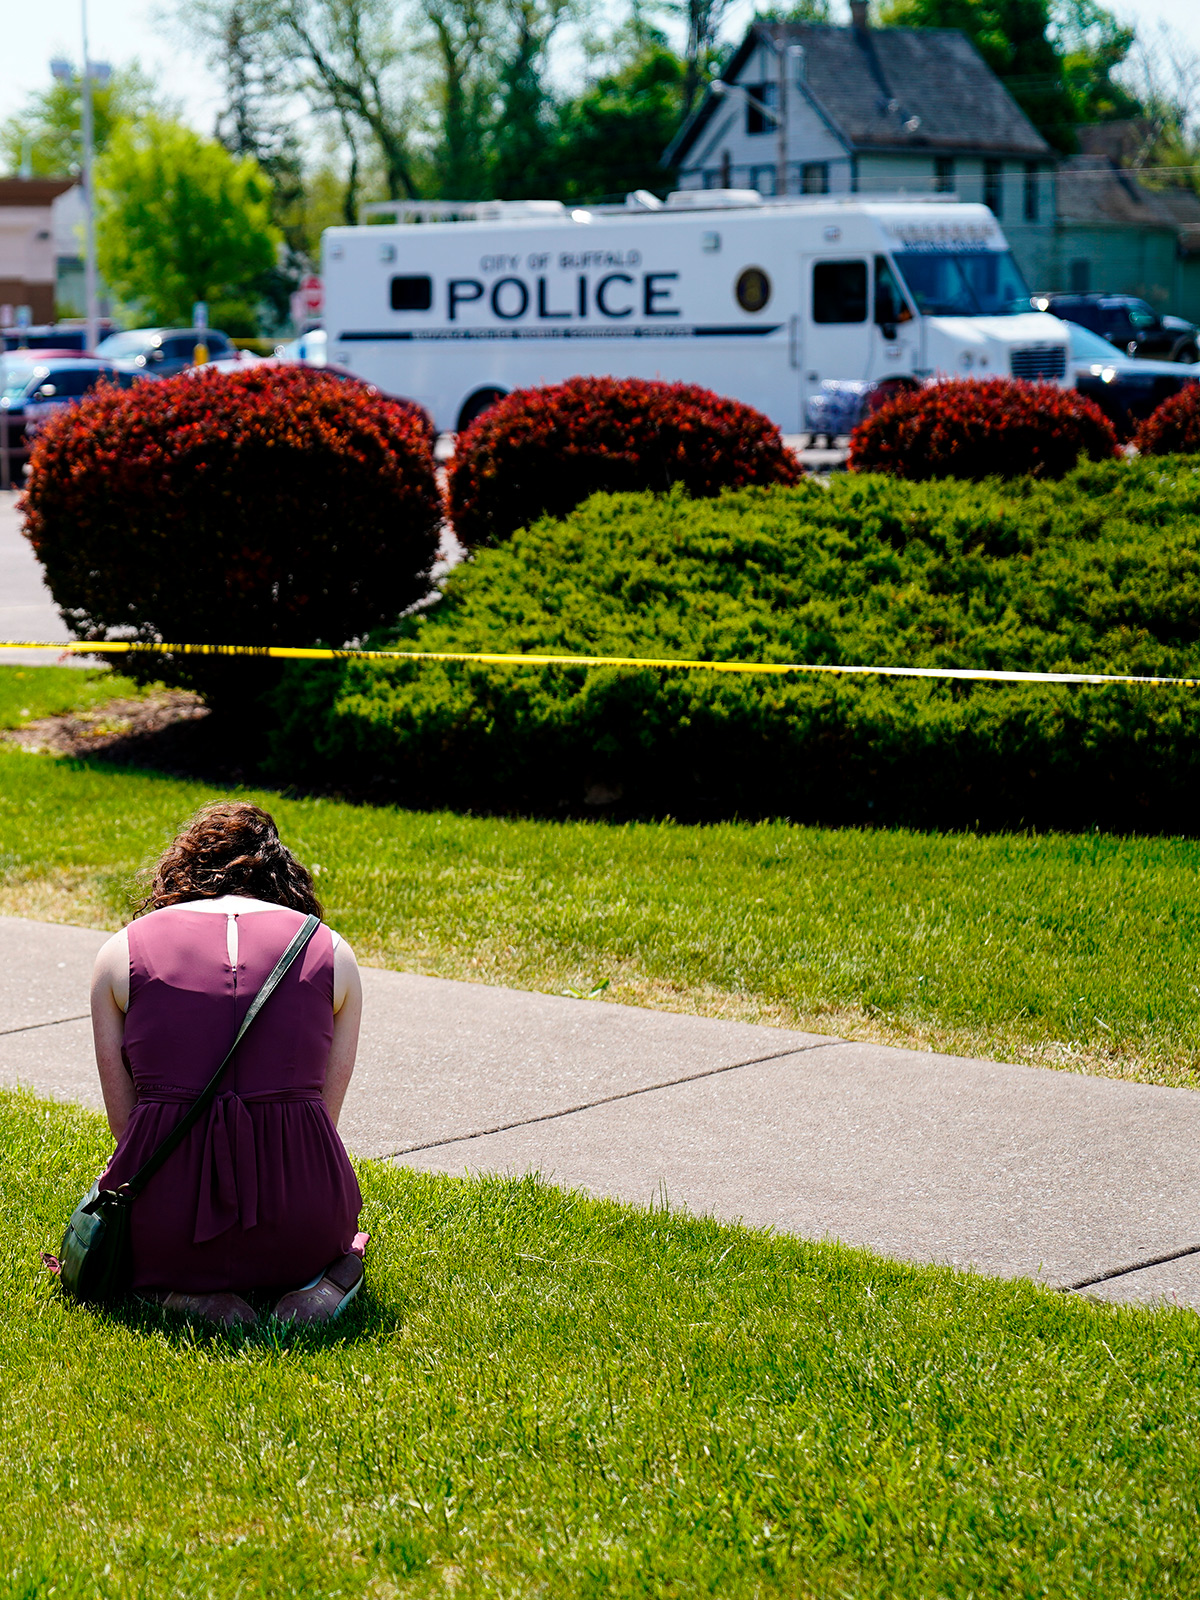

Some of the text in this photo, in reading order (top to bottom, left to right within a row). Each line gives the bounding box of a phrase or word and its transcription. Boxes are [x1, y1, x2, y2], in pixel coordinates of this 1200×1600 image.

[481, 250, 640, 271] CITY OF BUFFALO
[447, 272, 681, 321] POLICE
